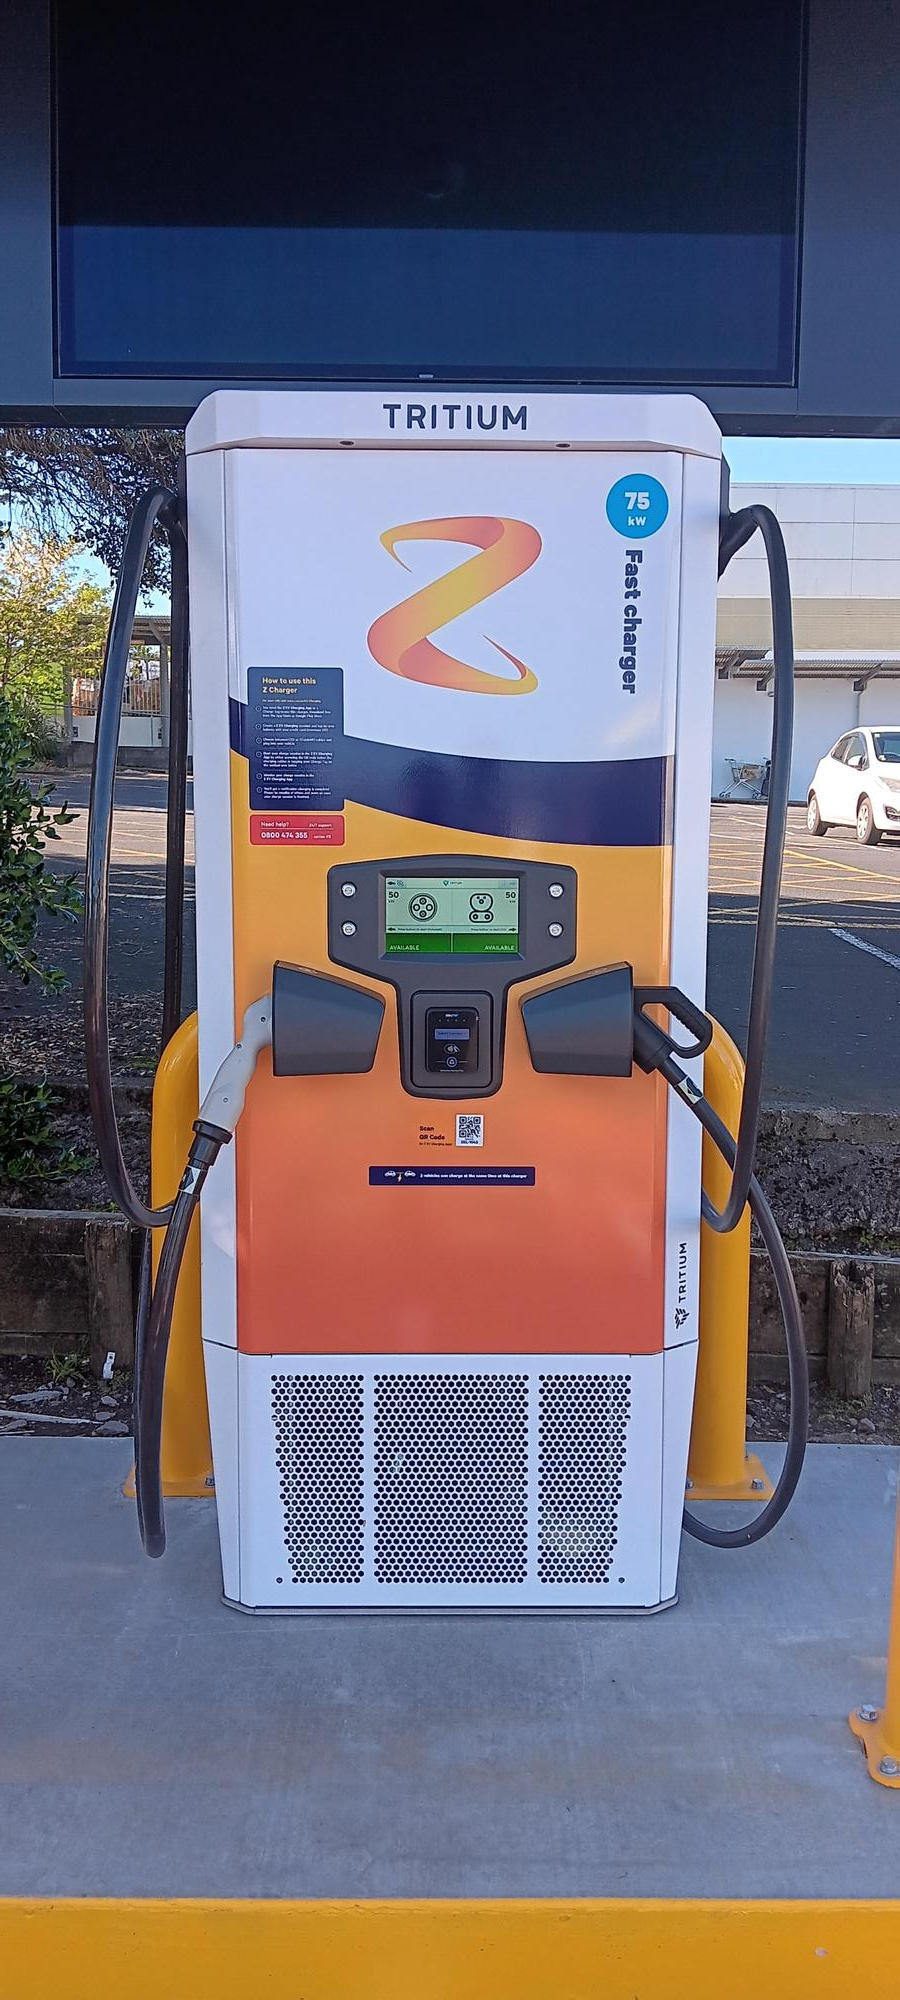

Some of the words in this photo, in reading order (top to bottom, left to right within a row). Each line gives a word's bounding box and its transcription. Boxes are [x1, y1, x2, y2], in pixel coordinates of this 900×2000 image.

[383, 404, 527, 430] TRITIUM
[625, 492, 650, 510] 75
[628, 517, 646, 526] kW
[624, 550, 643, 599] Fast
[619, 604, 642, 694] charger
[303, 677, 316, 685] this
[679, 1242, 687, 1303] TRITIUM
